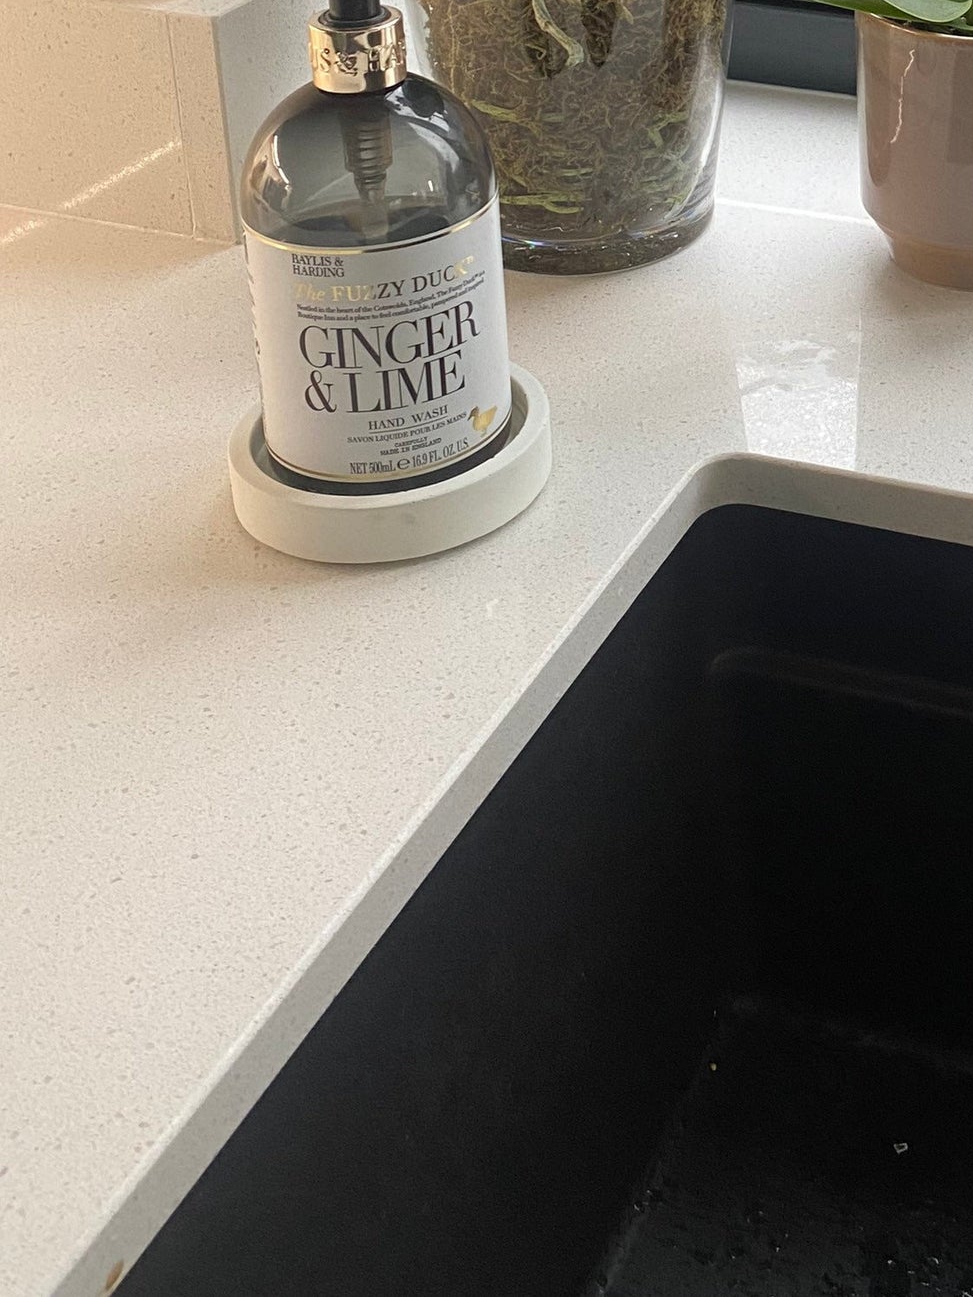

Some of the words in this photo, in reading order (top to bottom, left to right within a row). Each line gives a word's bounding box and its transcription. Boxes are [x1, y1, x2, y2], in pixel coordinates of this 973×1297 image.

[291, 253, 332, 267] BAYLIS
[334, 257, 344, 267] &
[292, 265, 345, 278] HARDING
[330, 280, 406, 302] FUZZY
[299, 301, 480, 369] GINGER
[305, 370, 338, 413] &
[343, 350, 465, 413] LIME
[347, 434, 375, 443] SAVON
[375, 431, 409, 442] LIQUIDE
[410, 424, 432, 436] POUR
[432, 420, 444, 430] LES
[446, 411, 468, 425] MAINS
[368, 417, 405, 431] HAND
[411, 404, 449, 423] WASH
[349, 462, 367, 475] NET
[412, 453, 428, 468] 16.9
